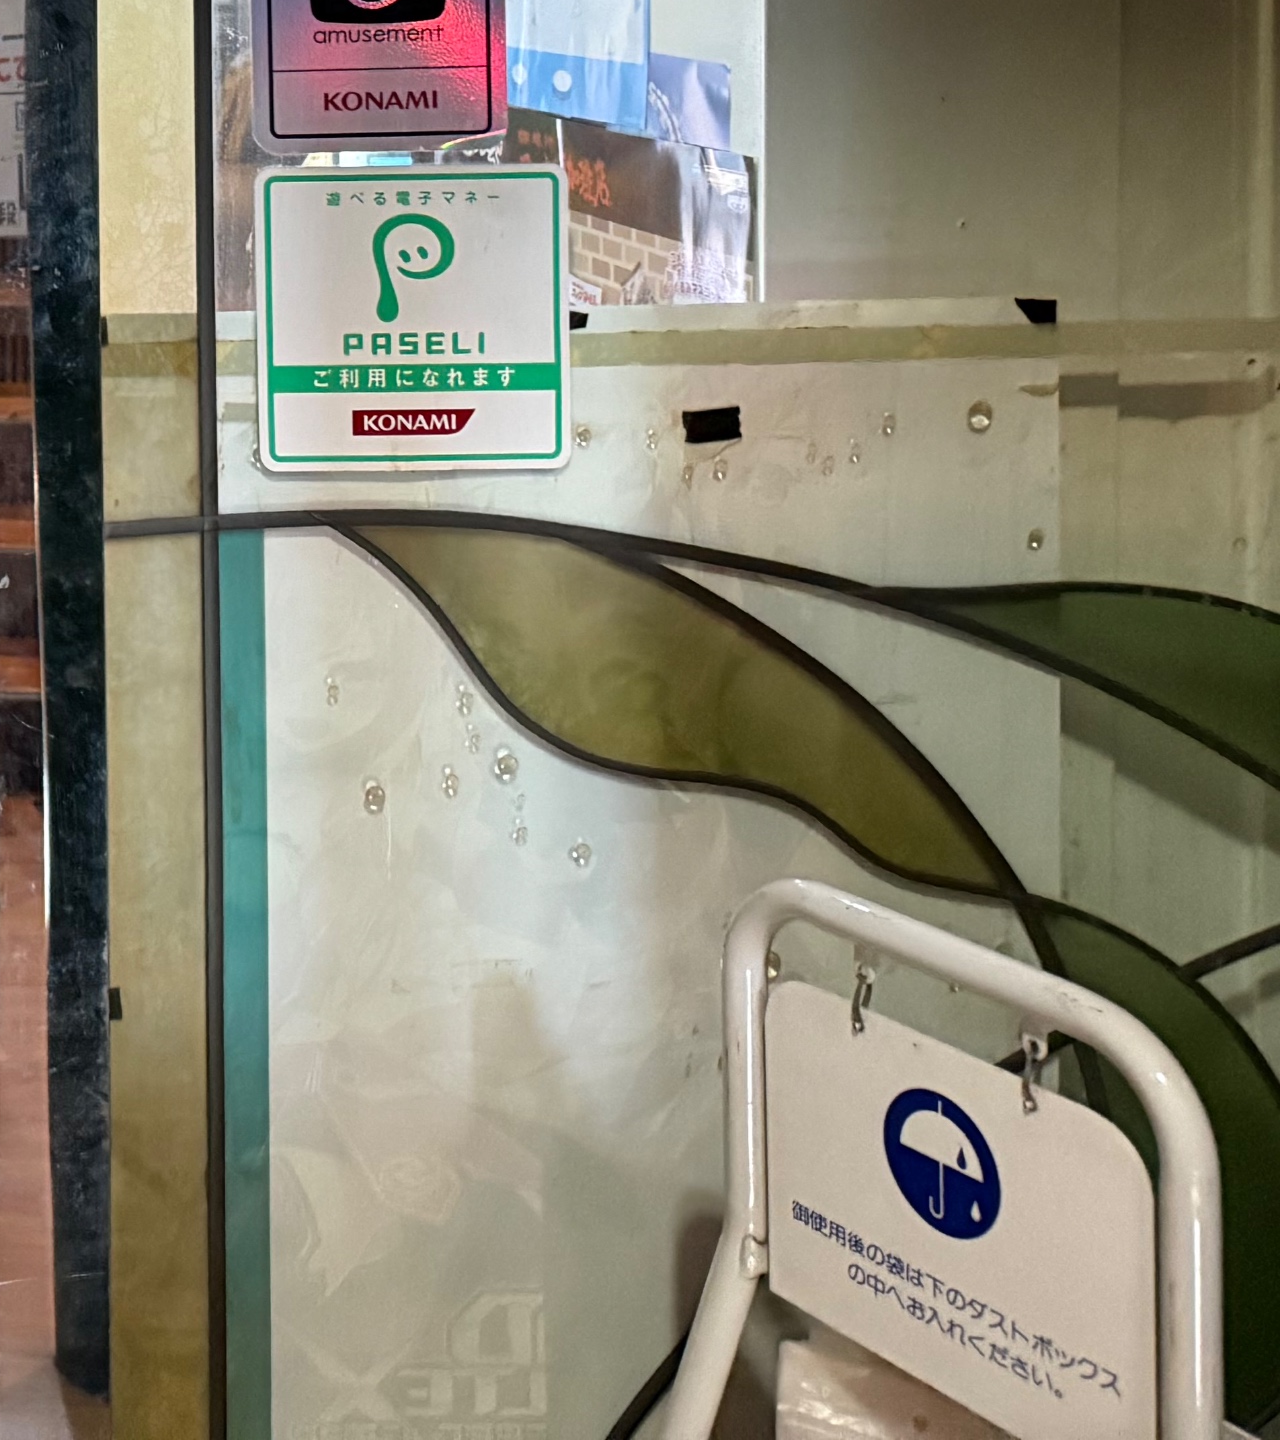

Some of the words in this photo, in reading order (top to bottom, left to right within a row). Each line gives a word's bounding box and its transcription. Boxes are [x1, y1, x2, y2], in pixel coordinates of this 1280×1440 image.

[313, 24, 444, 45] amusement
[323, 90, 438, 113] KONAMI
[325, 190, 500, 207] 遊べる電子マネー
[344, 333, 486, 355] PASELI
[313, 368, 515, 390] ご利用になれます
[362, 412, 458, 433] KONAMI
[792, 1200, 1122, 1398] 御使用後の袋は下のダストボックス
[848, 1263, 1063, 1399] の中へお入れください。
